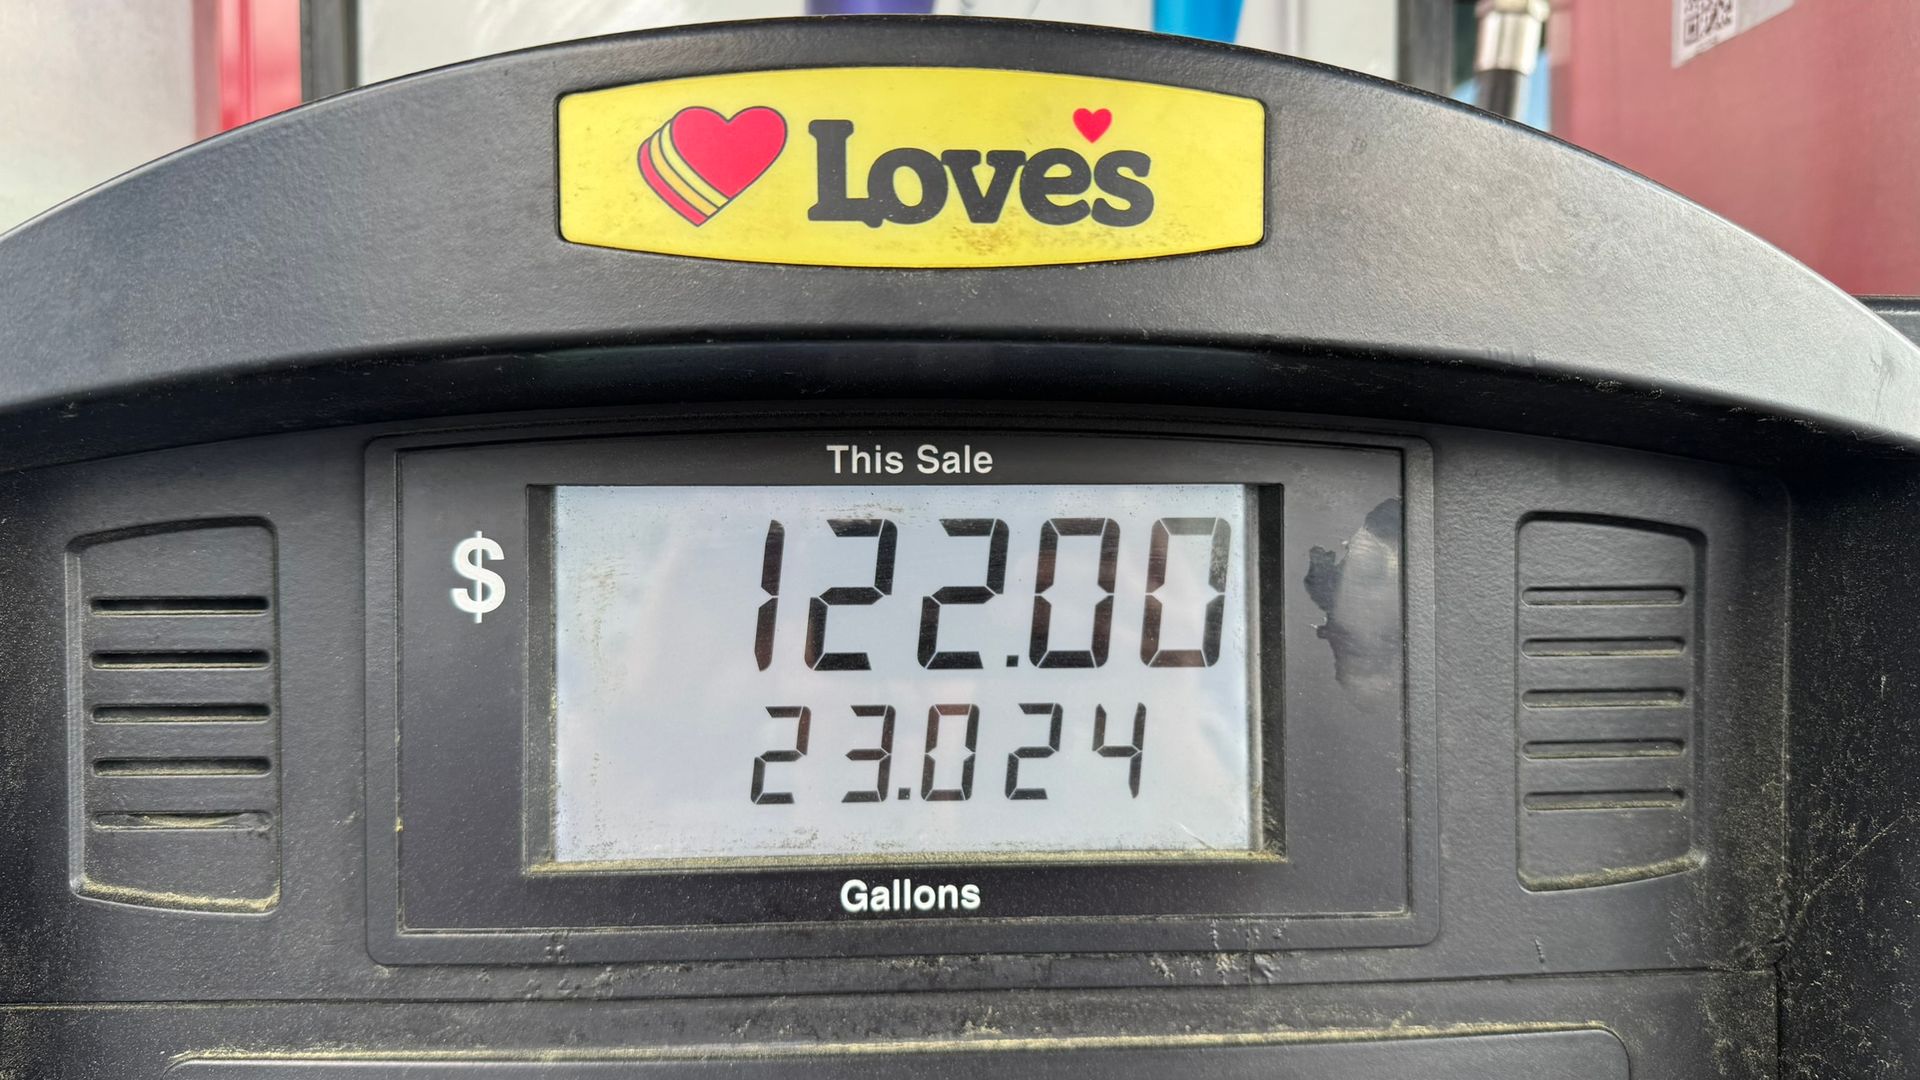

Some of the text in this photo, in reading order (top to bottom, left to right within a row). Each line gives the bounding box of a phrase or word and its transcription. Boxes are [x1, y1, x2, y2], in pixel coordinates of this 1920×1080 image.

[828, 444, 994, 475] This Sale
[451, 531, 506, 623] $
[754, 517, 1231, 671] 122.00
[750, 702, 1147, 806] 23.024
[839, 877, 982, 914] Gallons
